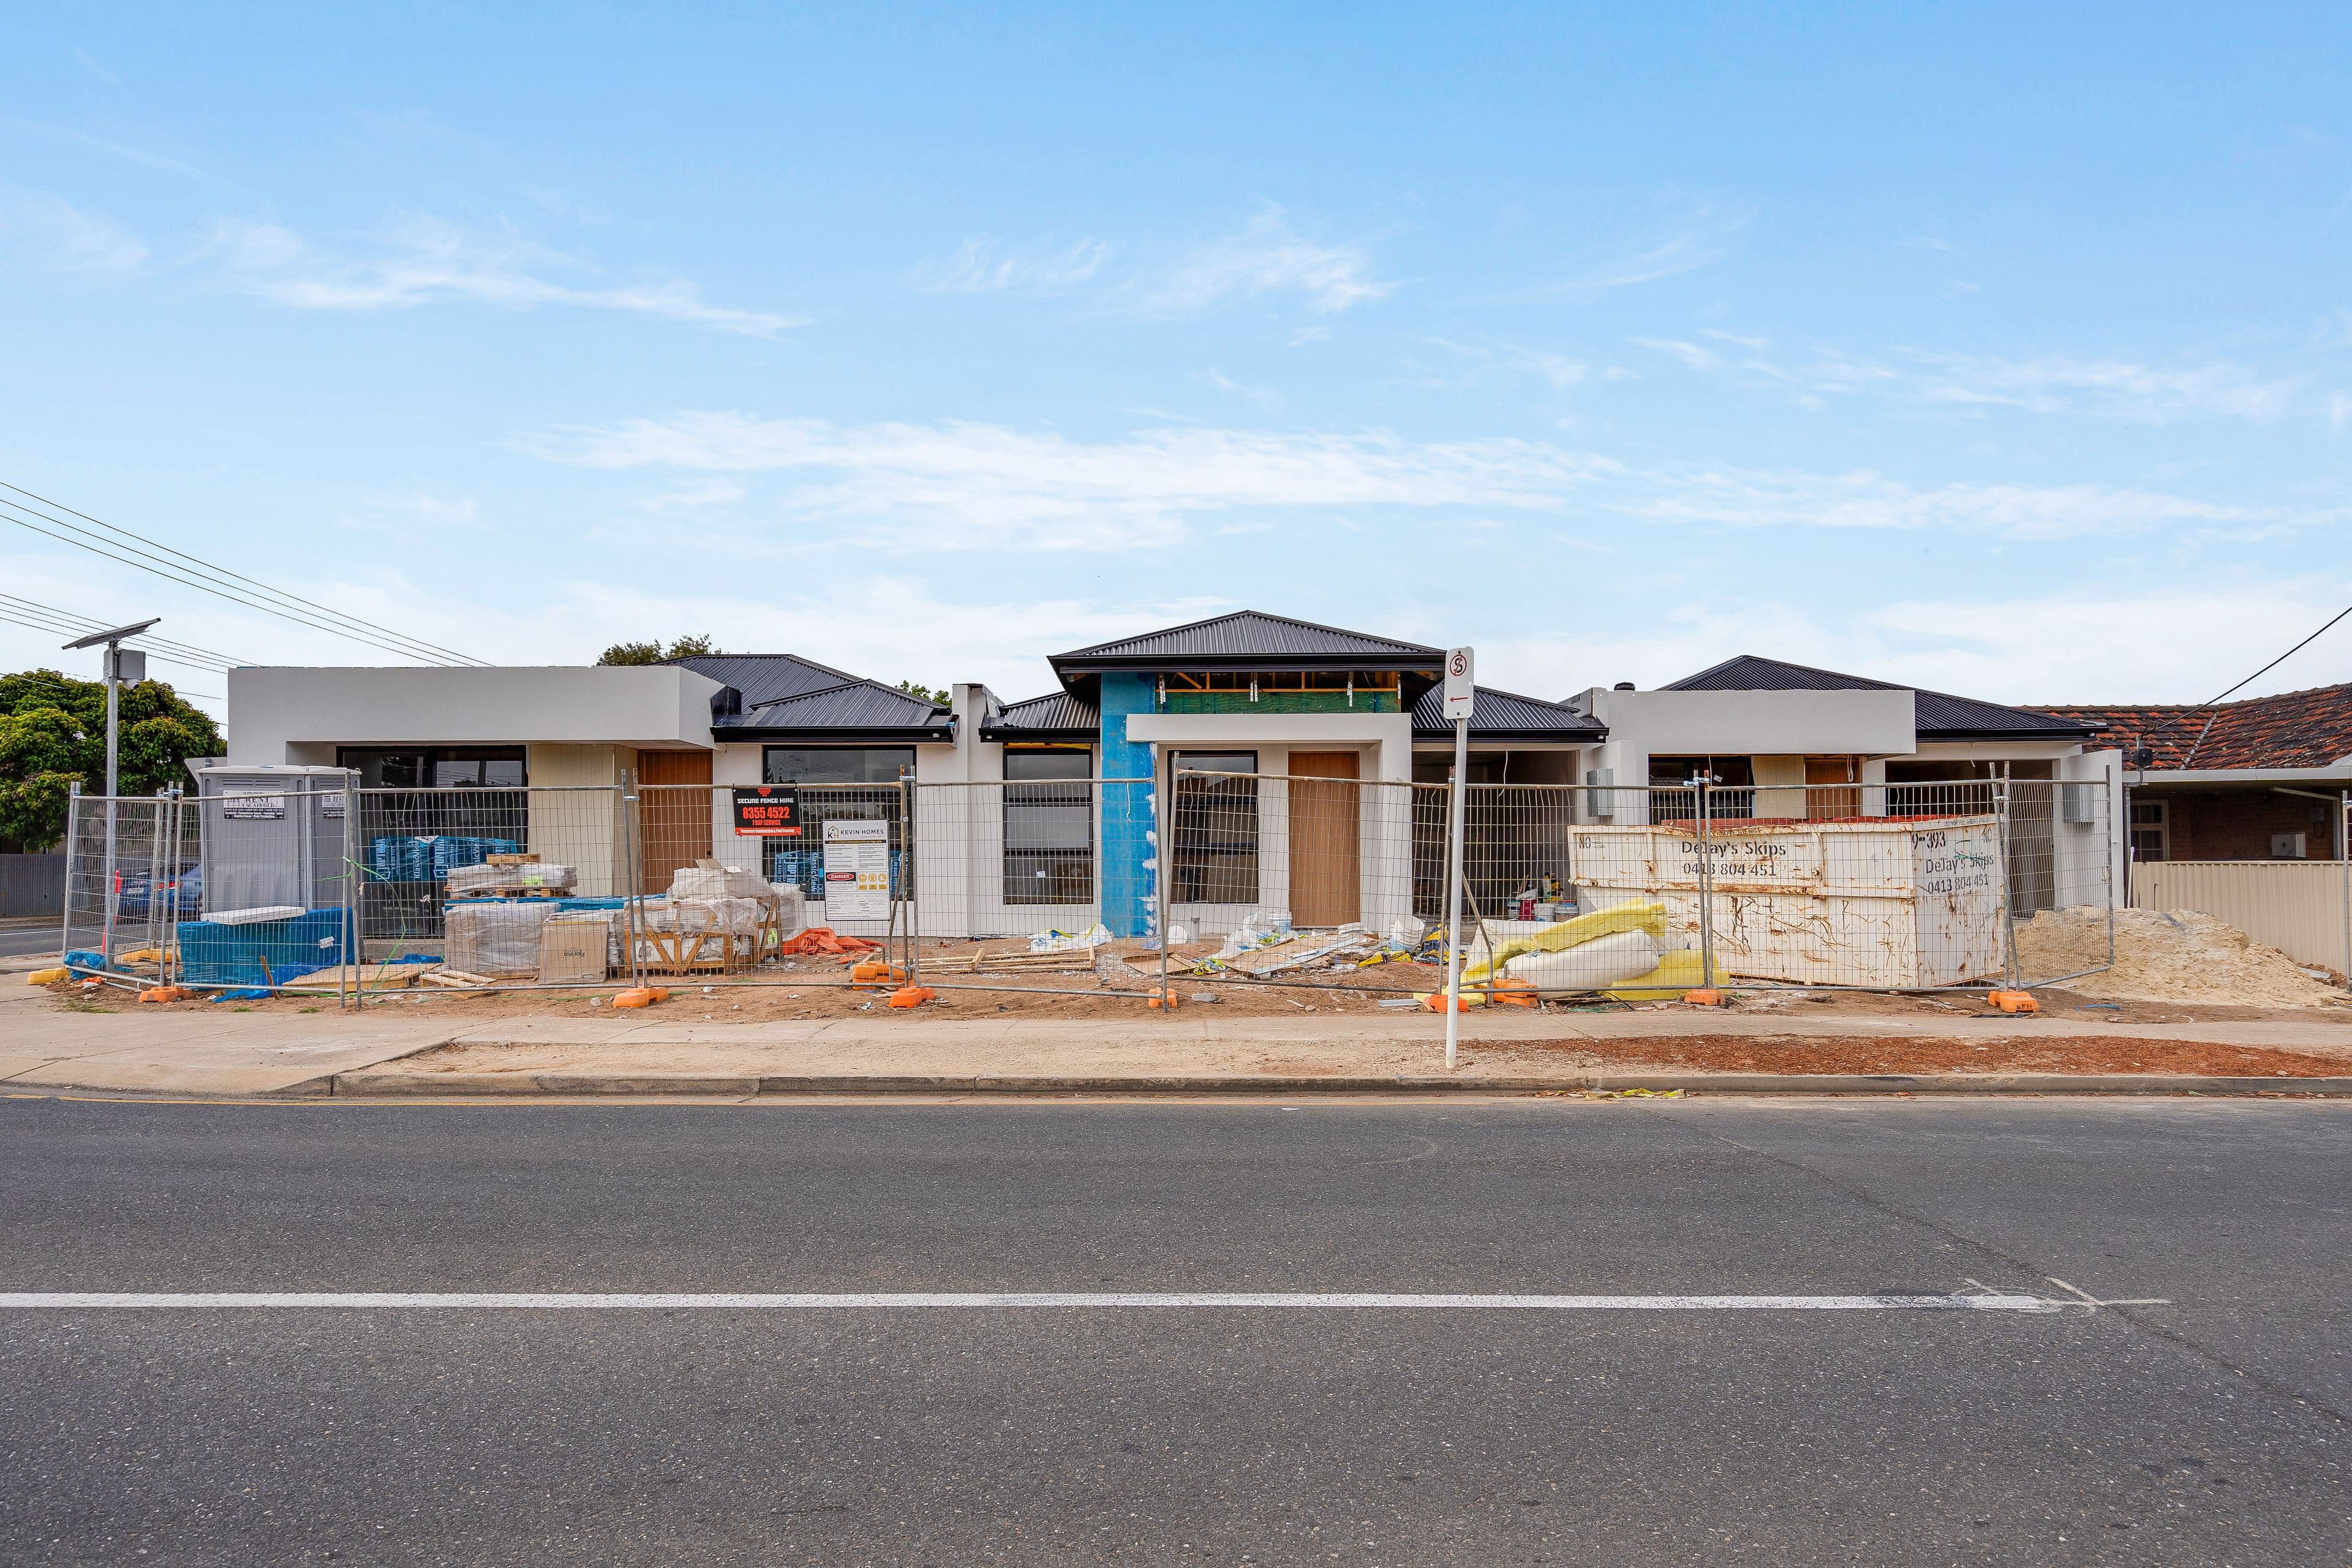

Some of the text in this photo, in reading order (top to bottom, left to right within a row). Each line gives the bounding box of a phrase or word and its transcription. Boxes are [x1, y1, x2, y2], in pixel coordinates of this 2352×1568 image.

[742, 807, 790, 819] 8355 4522
[1579, 837, 1591, 849] NO
[1912, 831, 1946, 850] 9-393
[1745, 841, 1786, 858] Skips
[1720, 864, 1746, 876] 804
[1751, 864, 1776, 876] 451
[1926, 851, 1994, 874] DeJay's Skips
[1928, 873, 1988, 894] 0413 804 451
